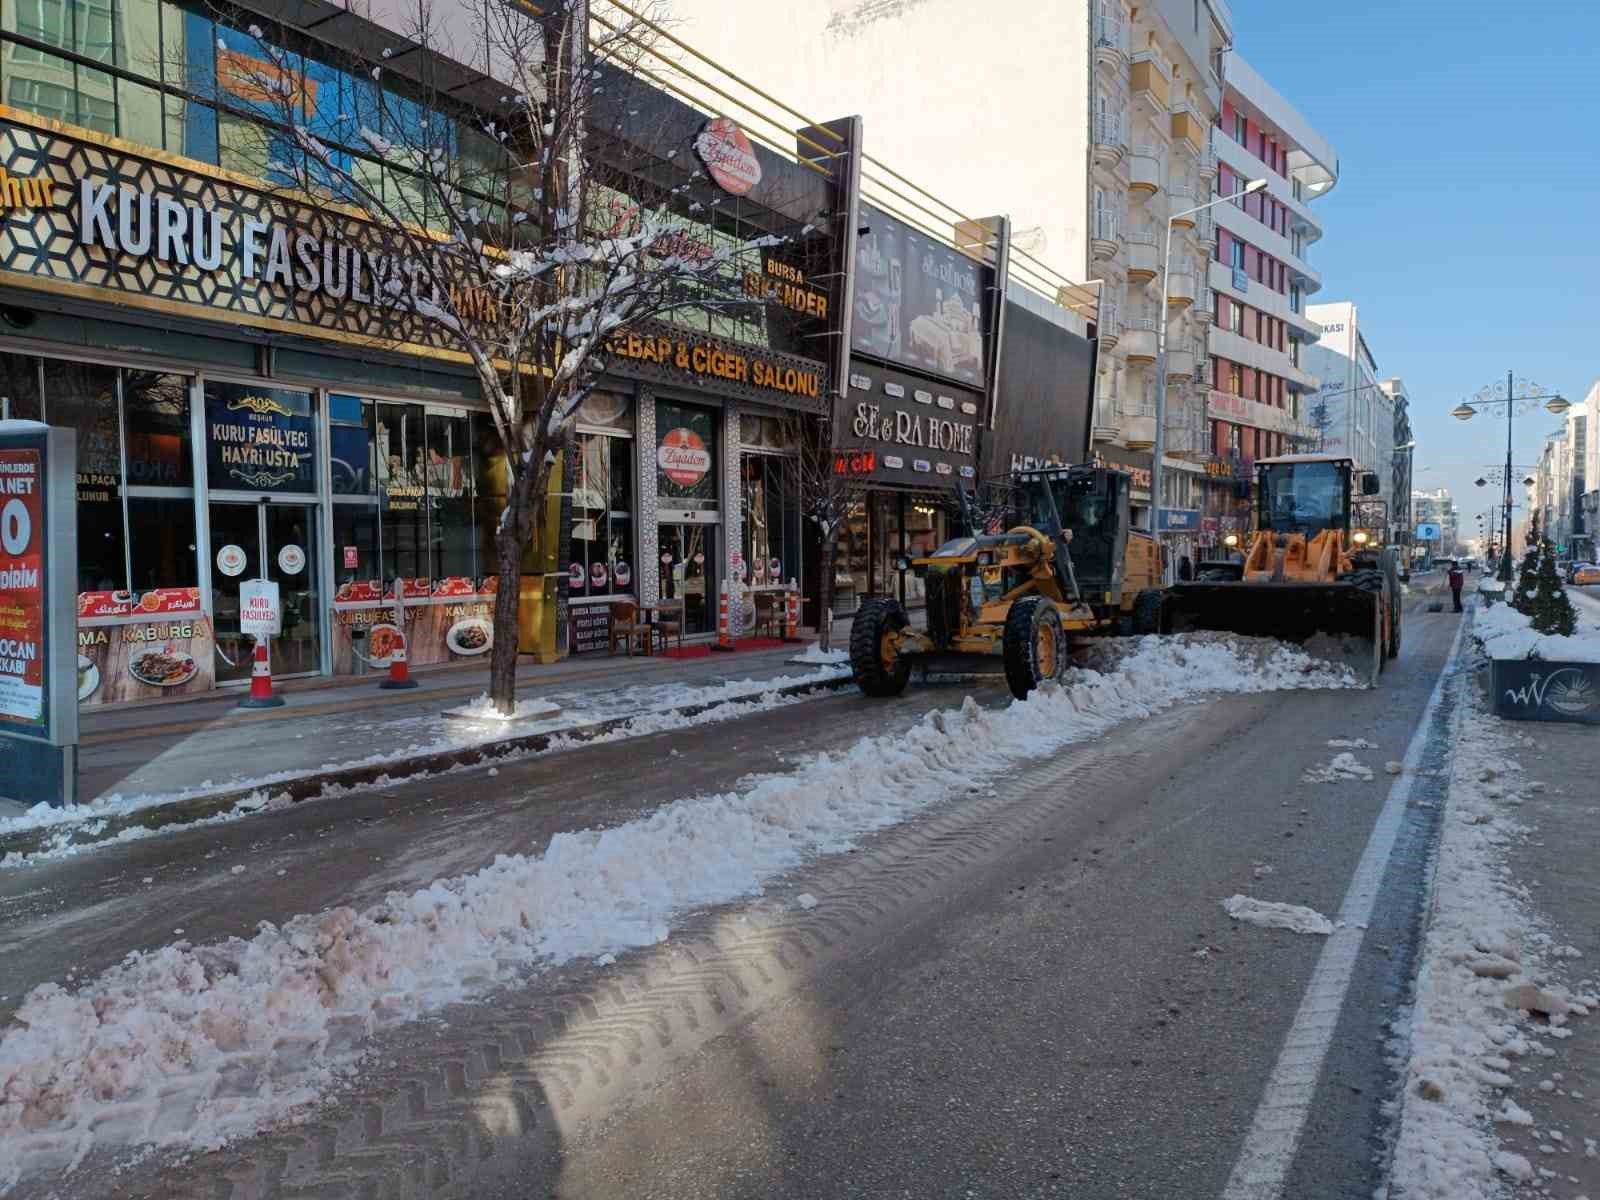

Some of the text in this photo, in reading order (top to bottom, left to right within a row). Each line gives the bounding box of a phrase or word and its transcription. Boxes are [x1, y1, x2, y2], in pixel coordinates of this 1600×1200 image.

[0, 166, 53, 208] hur
[80, 178, 222, 271] KURU
[767, 258, 804, 284] BURSA
[675, 341, 690, 369] &
[752, 358, 818, 398] SALONU
[213, 423, 246, 442] KURU
[854, 402, 880, 440] SE
[881, 418, 893, 441] &
[928, 417, 973, 454] HOME
[266, 450, 299, 468] USTA
[7, 477, 34, 495] NET
[249, 597, 270, 609] KURU
[374, 607, 424, 623] FASLYE
[121, 622, 204, 642] KABURGA
